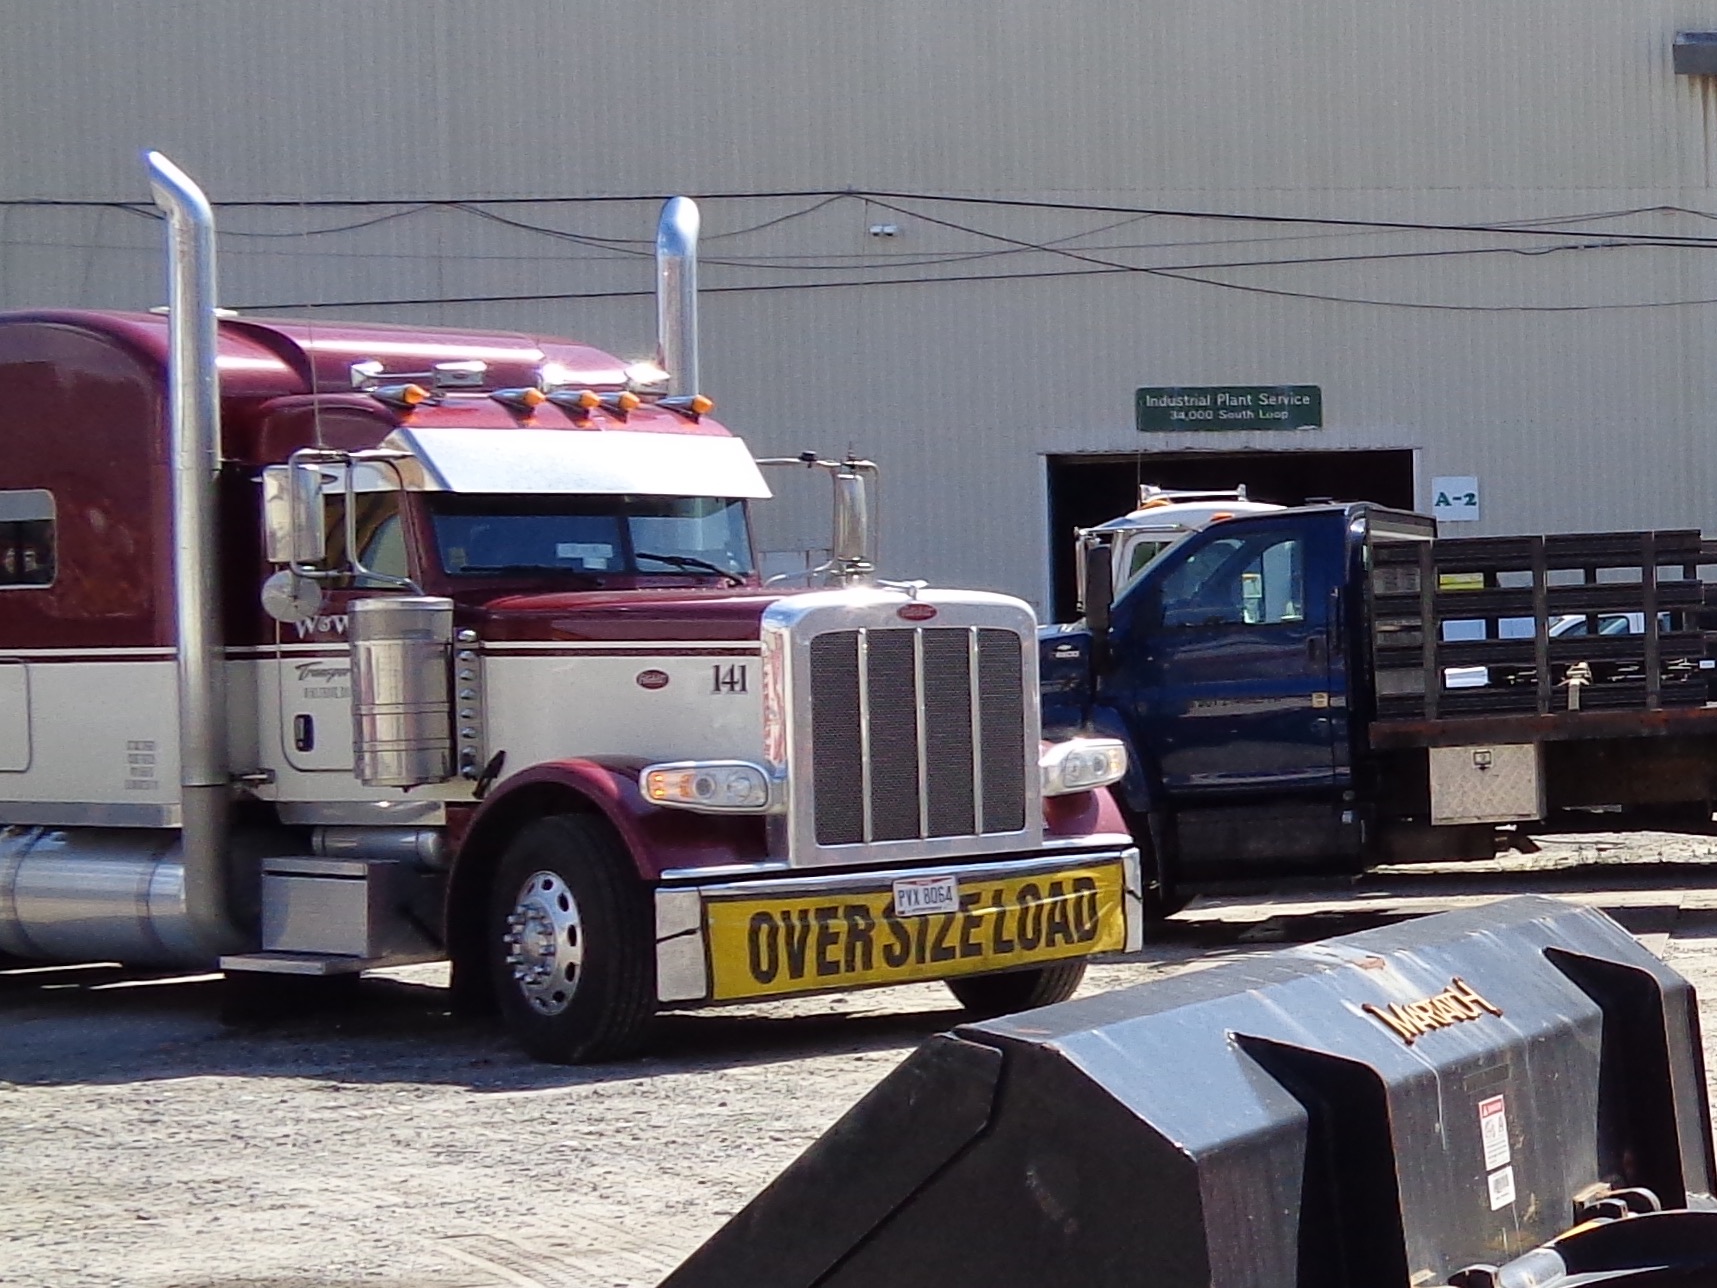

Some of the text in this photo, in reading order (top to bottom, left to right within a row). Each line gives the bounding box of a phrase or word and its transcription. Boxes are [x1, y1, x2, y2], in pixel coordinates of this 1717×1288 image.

[1146, 392, 1311, 407] Industrial Plant Service
[1218, 410, 1255, 420] South
[1259, 409, 1289, 420] Loop
[1434, 491, 1478, 507] A-2
[712, 663, 748, 693] 141
[991, 876, 1100, 955] LOAD
